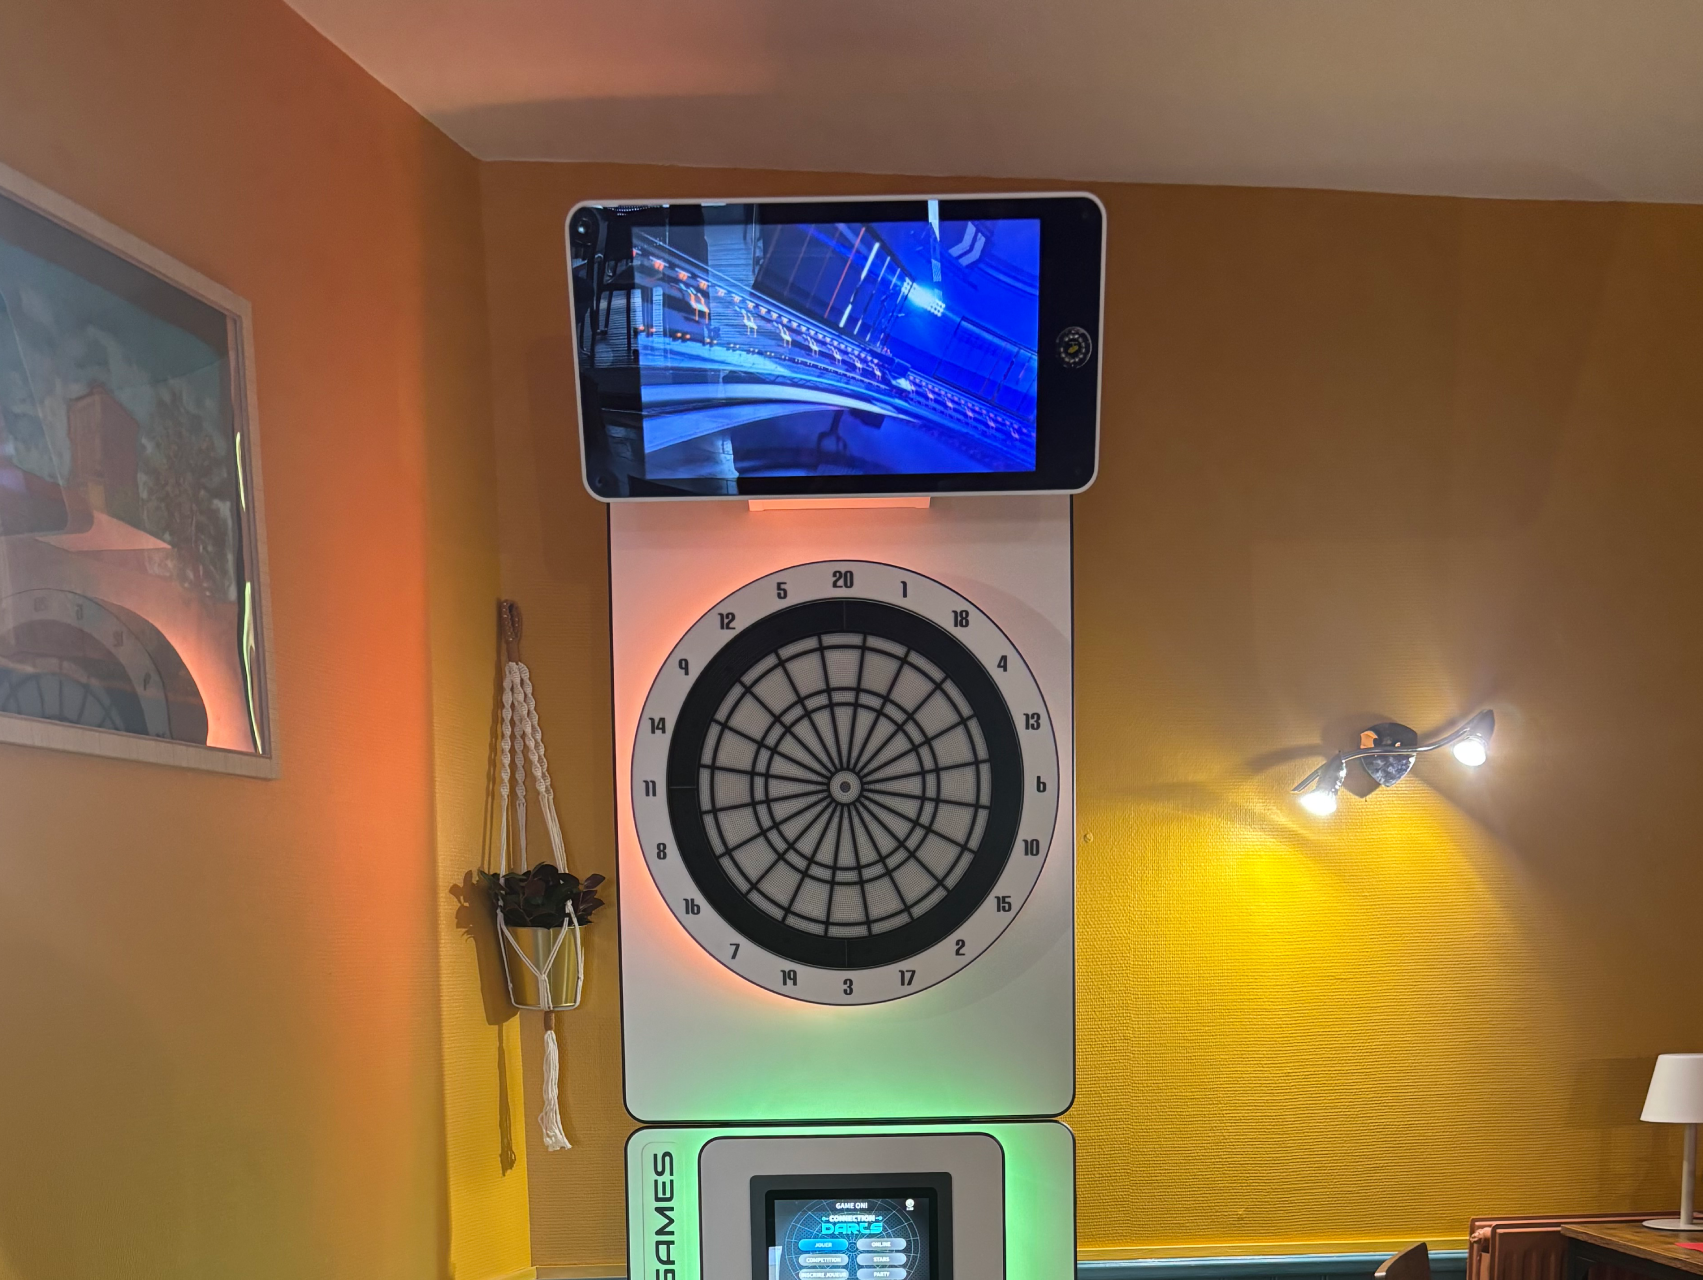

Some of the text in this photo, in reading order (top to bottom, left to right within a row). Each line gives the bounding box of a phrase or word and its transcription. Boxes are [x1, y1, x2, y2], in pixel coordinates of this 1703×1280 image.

[832, 571, 854, 588] 20
[777, 582, 788, 599] 5
[901, 581, 908, 598] 1
[718, 612, 736, 630] 12
[952, 610, 969, 628] 18
[678, 659, 689, 676] 9
[997, 655, 1008, 672] 4
[649, 717, 666, 735] 14
[1023, 713, 1041, 730] 13
[643, 780, 657, 797] 11
[656, 843, 667, 860] 8
[1022, 839, 1040, 856] 10
[995, 896, 1012, 913] 15
[729, 942, 740, 960] 7
[955, 939, 966, 956] 2
[780, 970, 797, 987] 19
[899, 970, 916, 987] 17
[843, 979, 854, 996] 3
[829, 1214, 876, 1222] CONNECTION
[821, 1222, 883, 1235] DARTS
